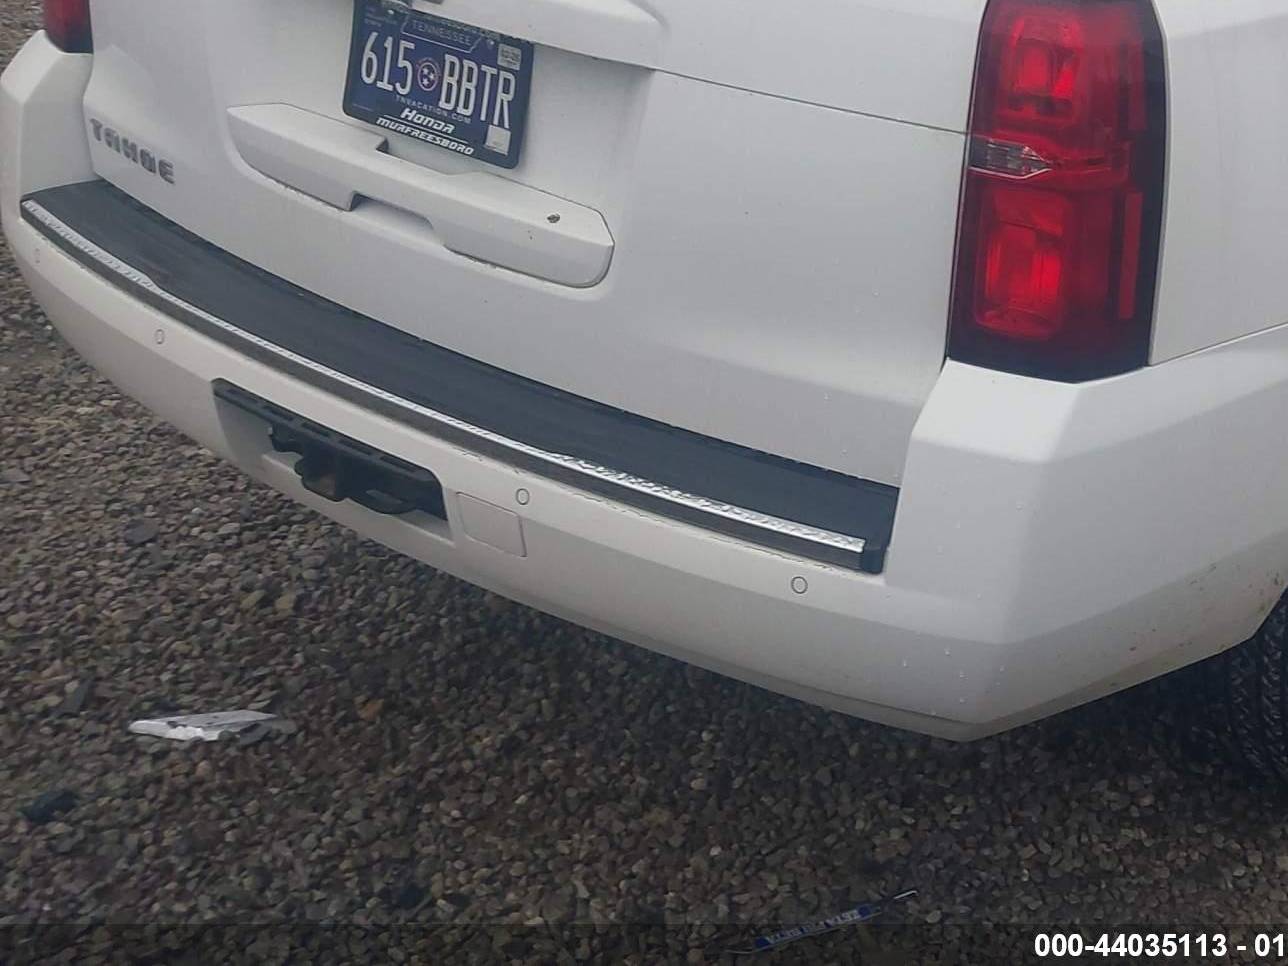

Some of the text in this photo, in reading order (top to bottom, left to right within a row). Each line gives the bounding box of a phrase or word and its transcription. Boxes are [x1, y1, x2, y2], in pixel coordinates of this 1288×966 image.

[411, 19, 472, 47] TENNESSEE
[360, 31, 516, 129] 615 BBTR
[89, 117, 176, 185] TAHOE
